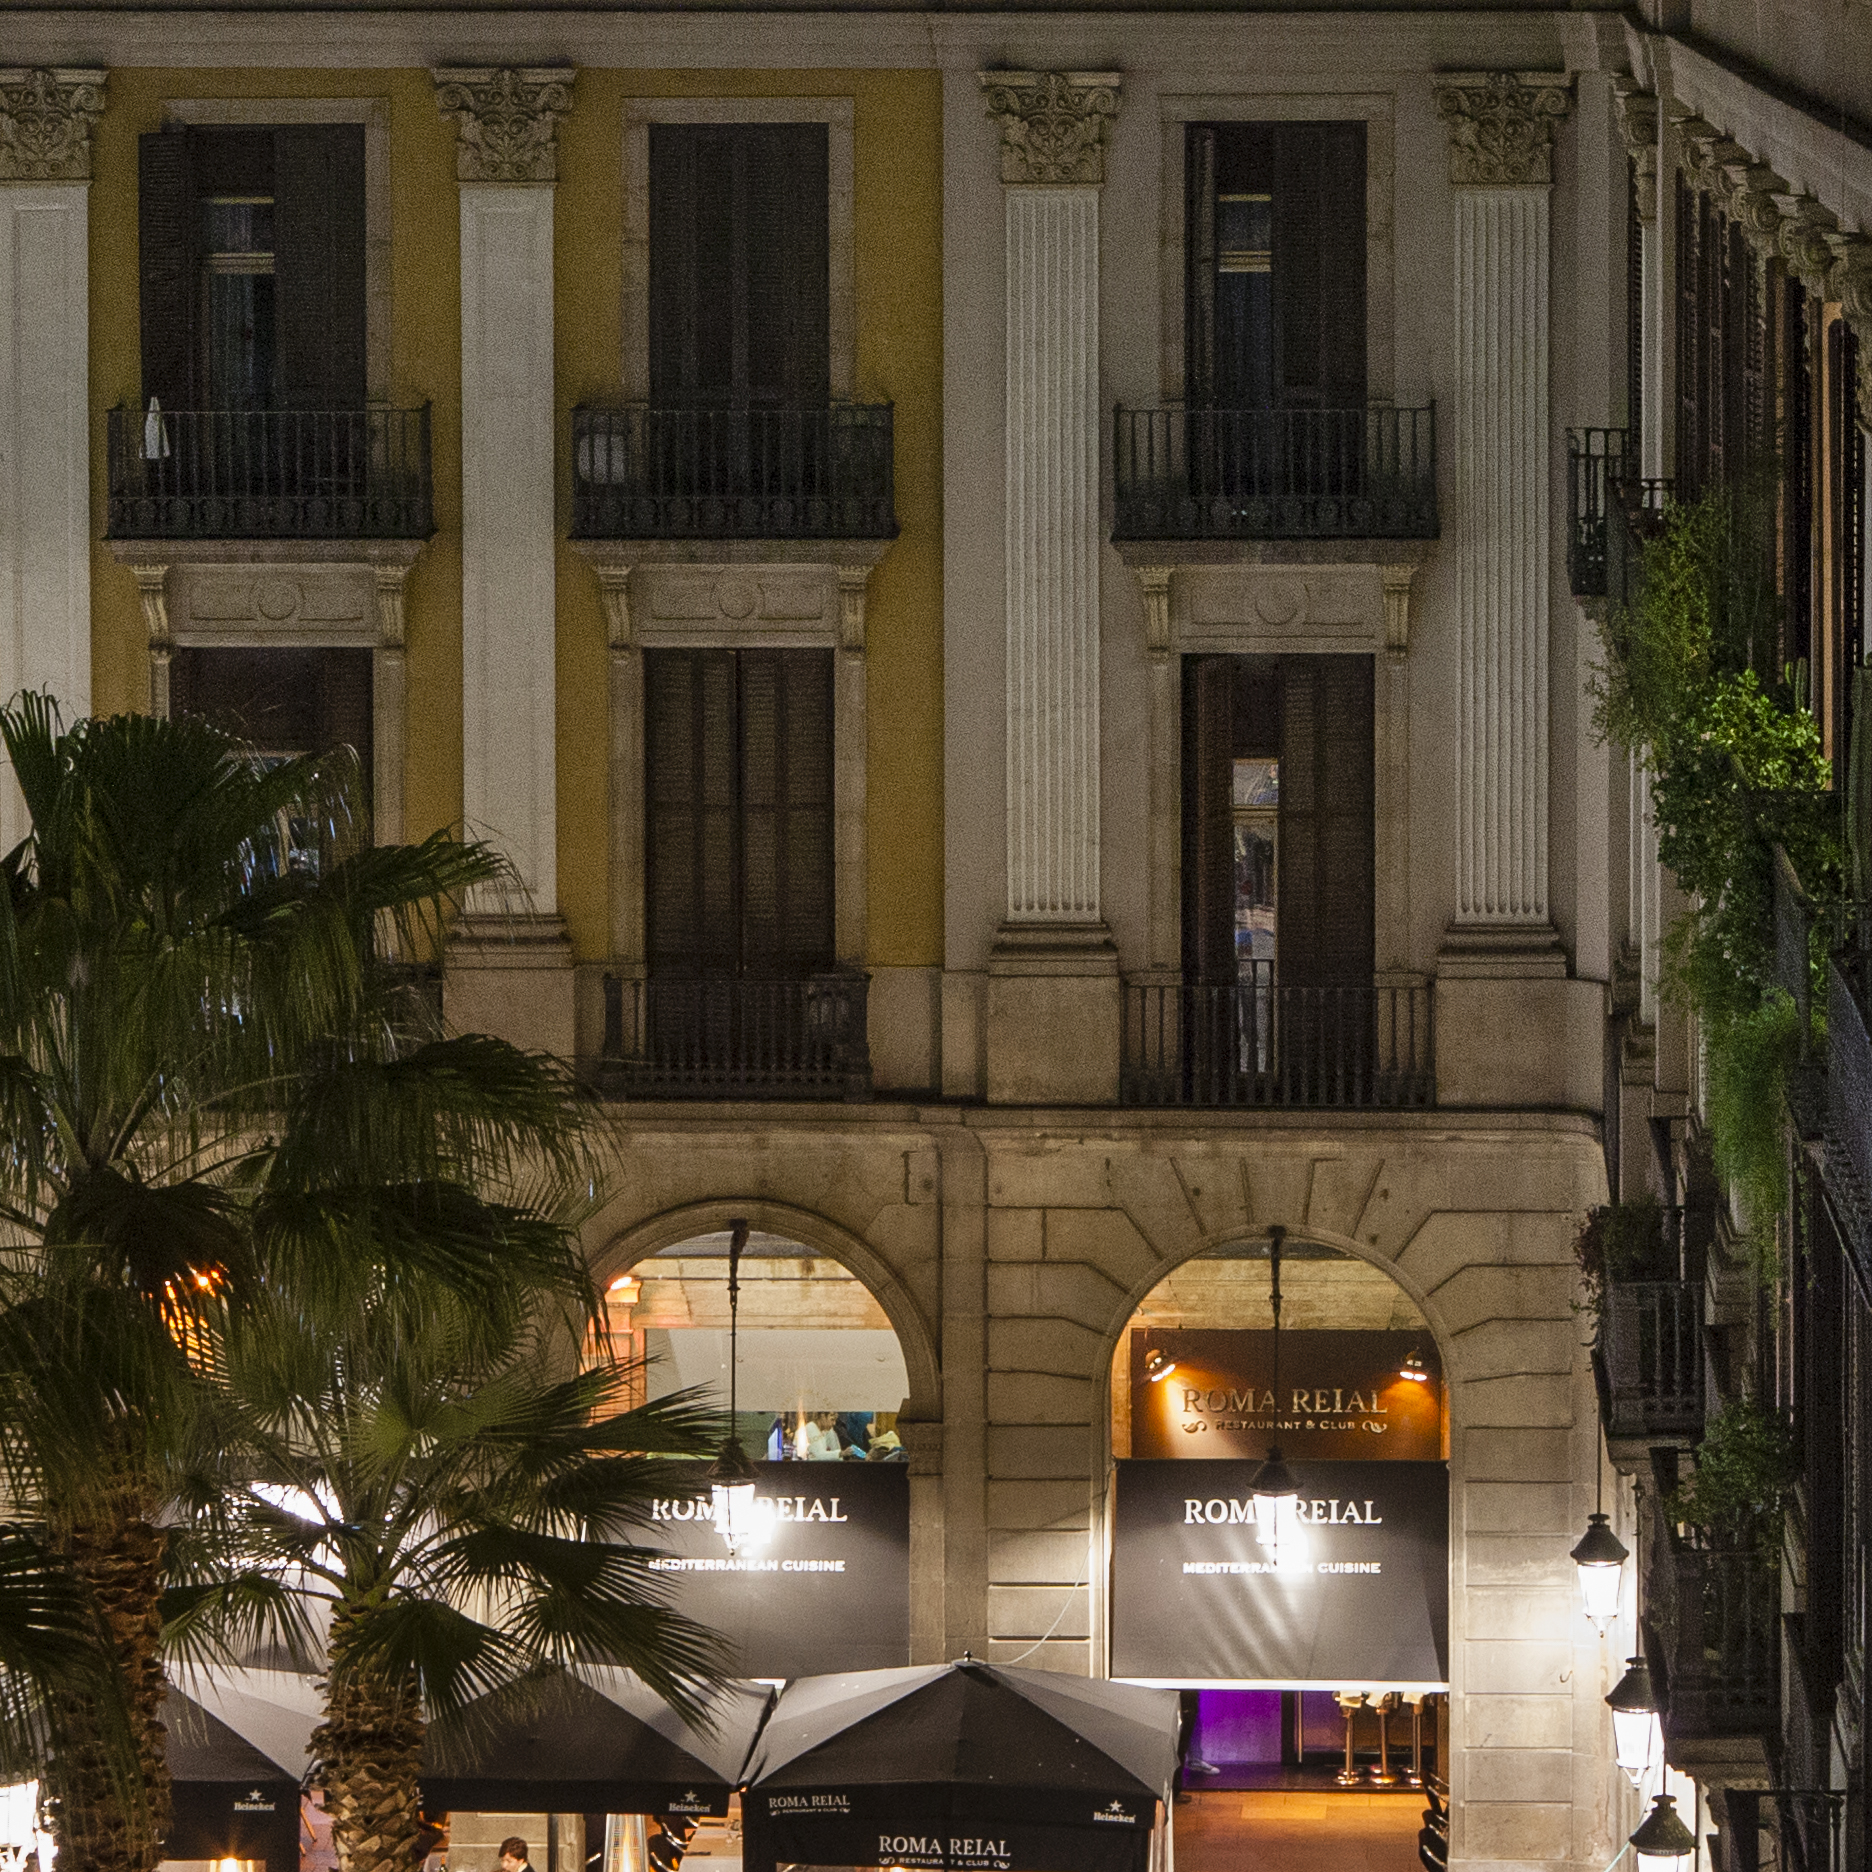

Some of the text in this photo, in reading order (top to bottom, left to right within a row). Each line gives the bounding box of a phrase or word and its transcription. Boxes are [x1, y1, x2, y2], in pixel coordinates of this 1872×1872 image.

[1183, 1388, 1388, 1414] ROMA REIAL
[1306, 1420, 1316, 1430] &
[652, 1496, 718, 1522] ROM
[1184, 1499, 1259, 1525] ROM
[781, 1559, 846, 1572] CUISINE
[1317, 1562, 1382, 1574] CUISINE
[234, 1802, 276, 1811] Heineken
[669, 1803, 711, 1813] Heineken
[769, 1795, 851, 1809] ROMA REIAL
[1093, 1811, 1136, 1823] Heineken
[879, 1835, 1011, 1857] ROMA REIAL
[899, 1858, 956, 1866] RESTAURAT
